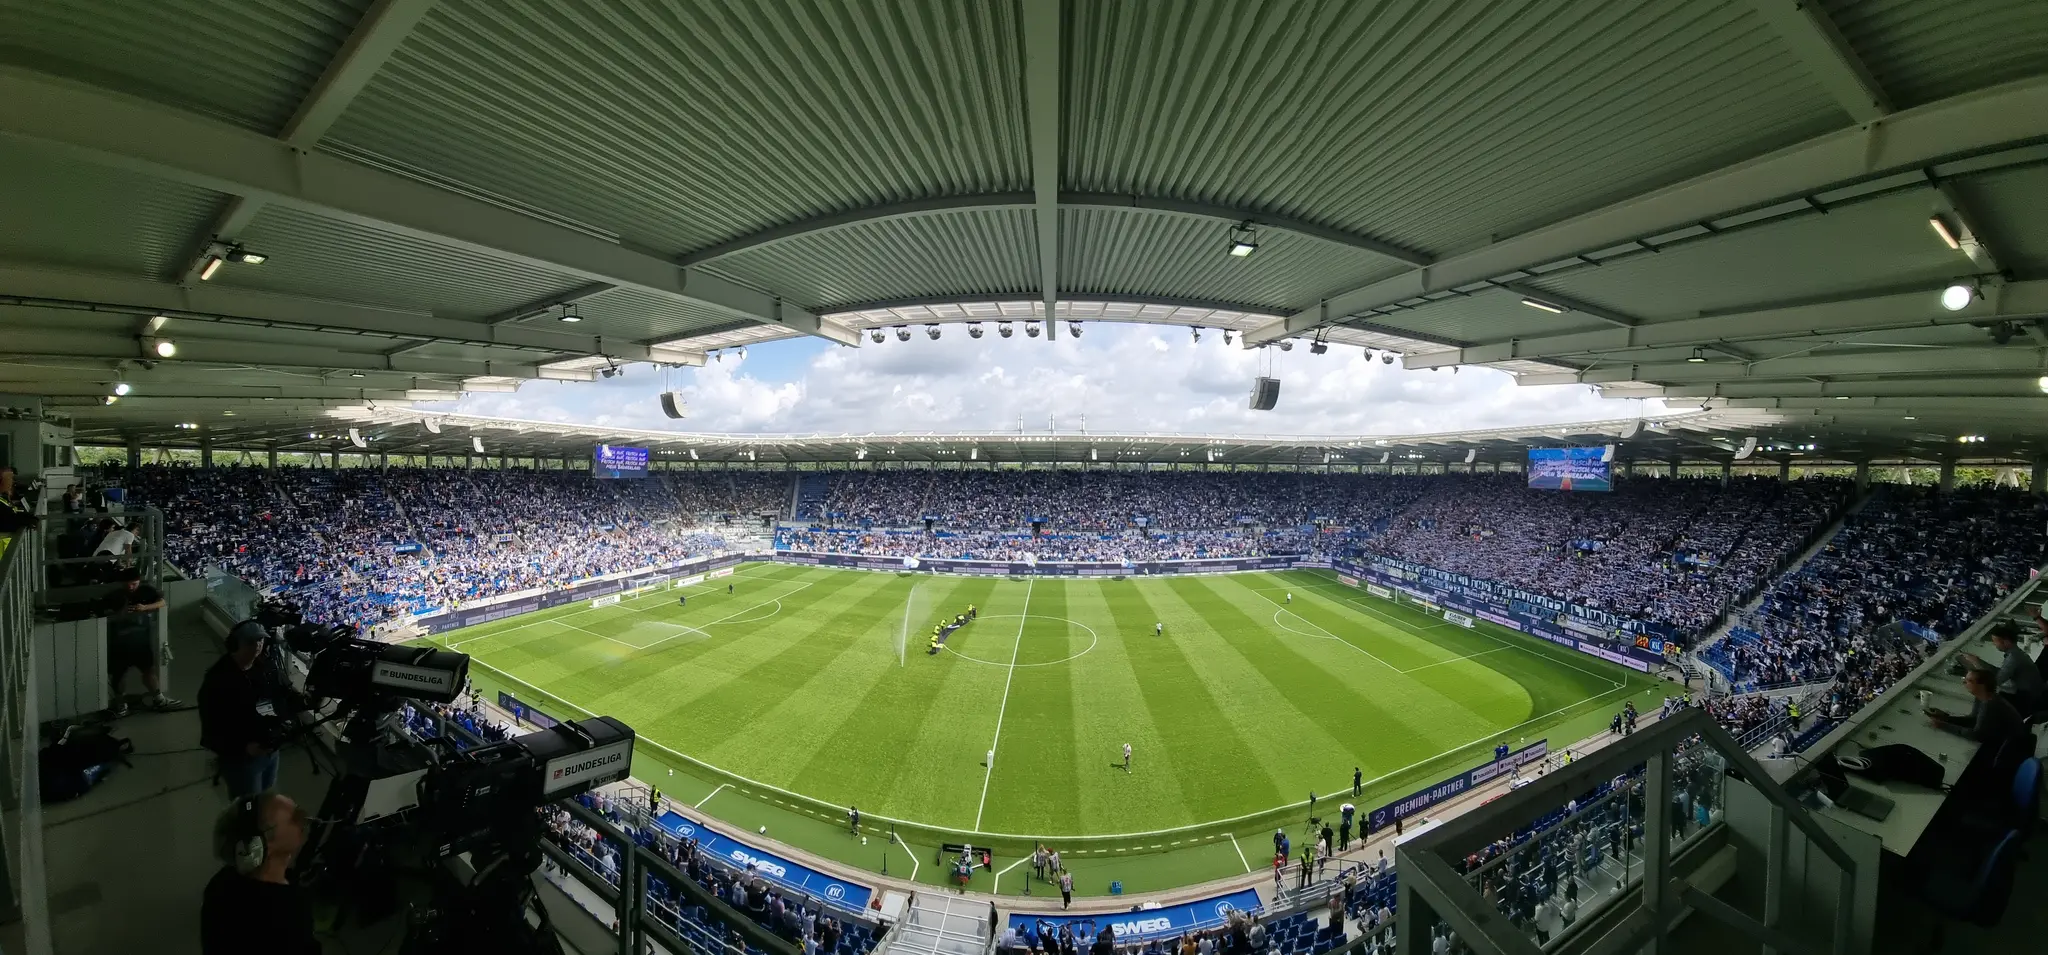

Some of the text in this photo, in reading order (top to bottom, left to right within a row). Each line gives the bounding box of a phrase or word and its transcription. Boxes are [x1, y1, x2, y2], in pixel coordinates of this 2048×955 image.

[389, 670, 443, 685] BUNDESLIGA
[564, 752, 622, 777] BUNDESLIGA
[1394, 778, 1464, 818] PREMIUM-PARTNER
[730, 850, 787, 878] SWEG
[828, 886, 842, 898] KSC
[1112, 917, 1171, 936] SWEG
